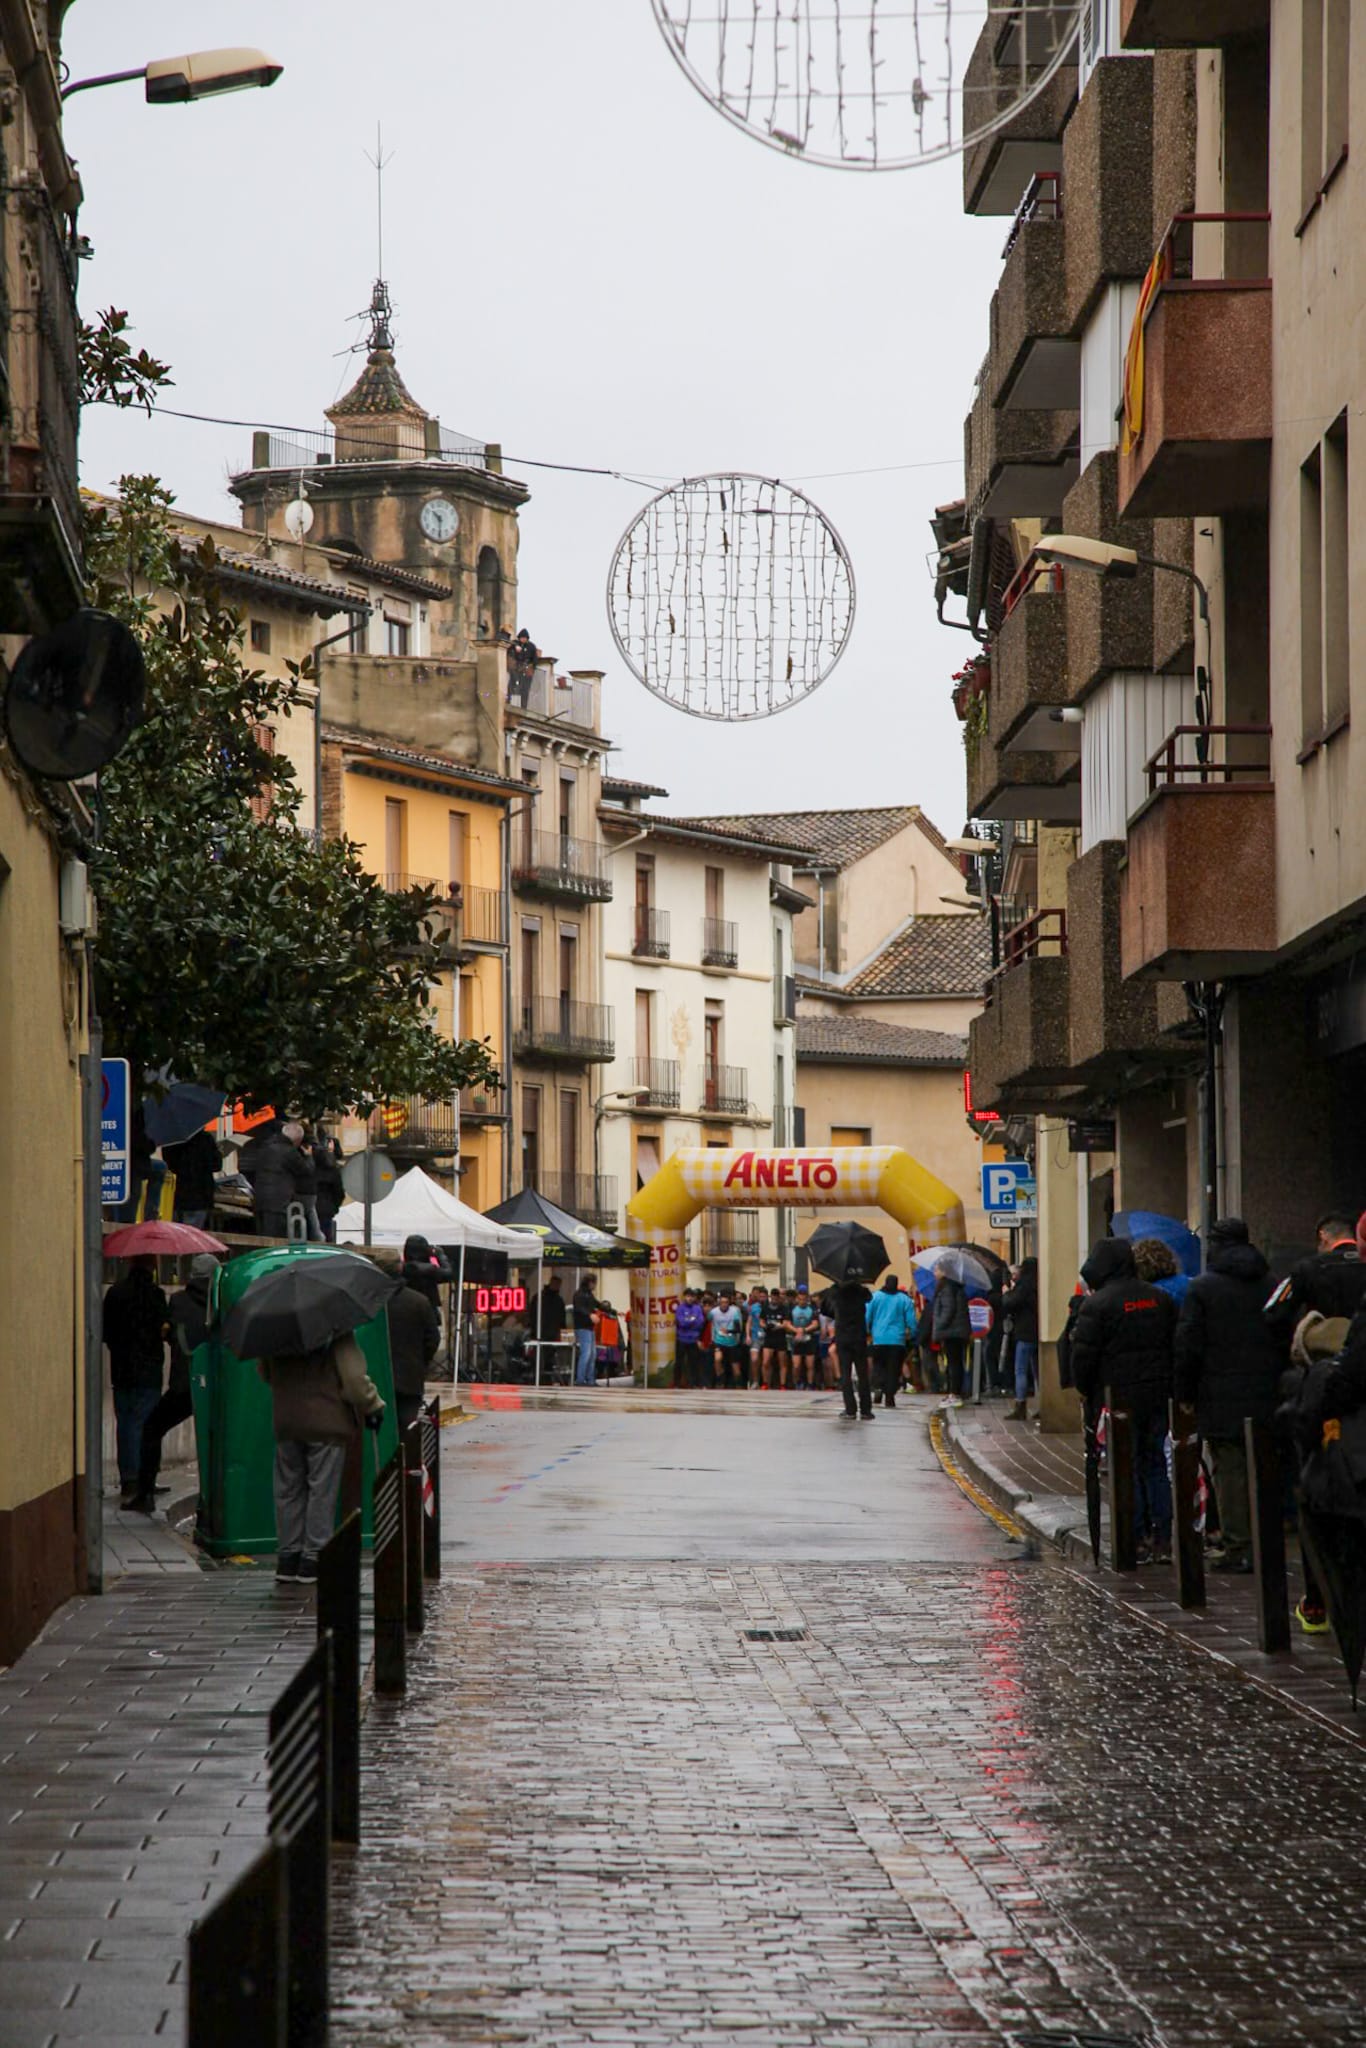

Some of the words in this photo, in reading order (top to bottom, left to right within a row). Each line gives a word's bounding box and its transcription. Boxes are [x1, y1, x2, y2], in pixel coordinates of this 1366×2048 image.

[723, 1152, 838, 1189] ANETO
[990, 1170, 1016, 1205] P
[650, 1244, 679, 1264] ETO
